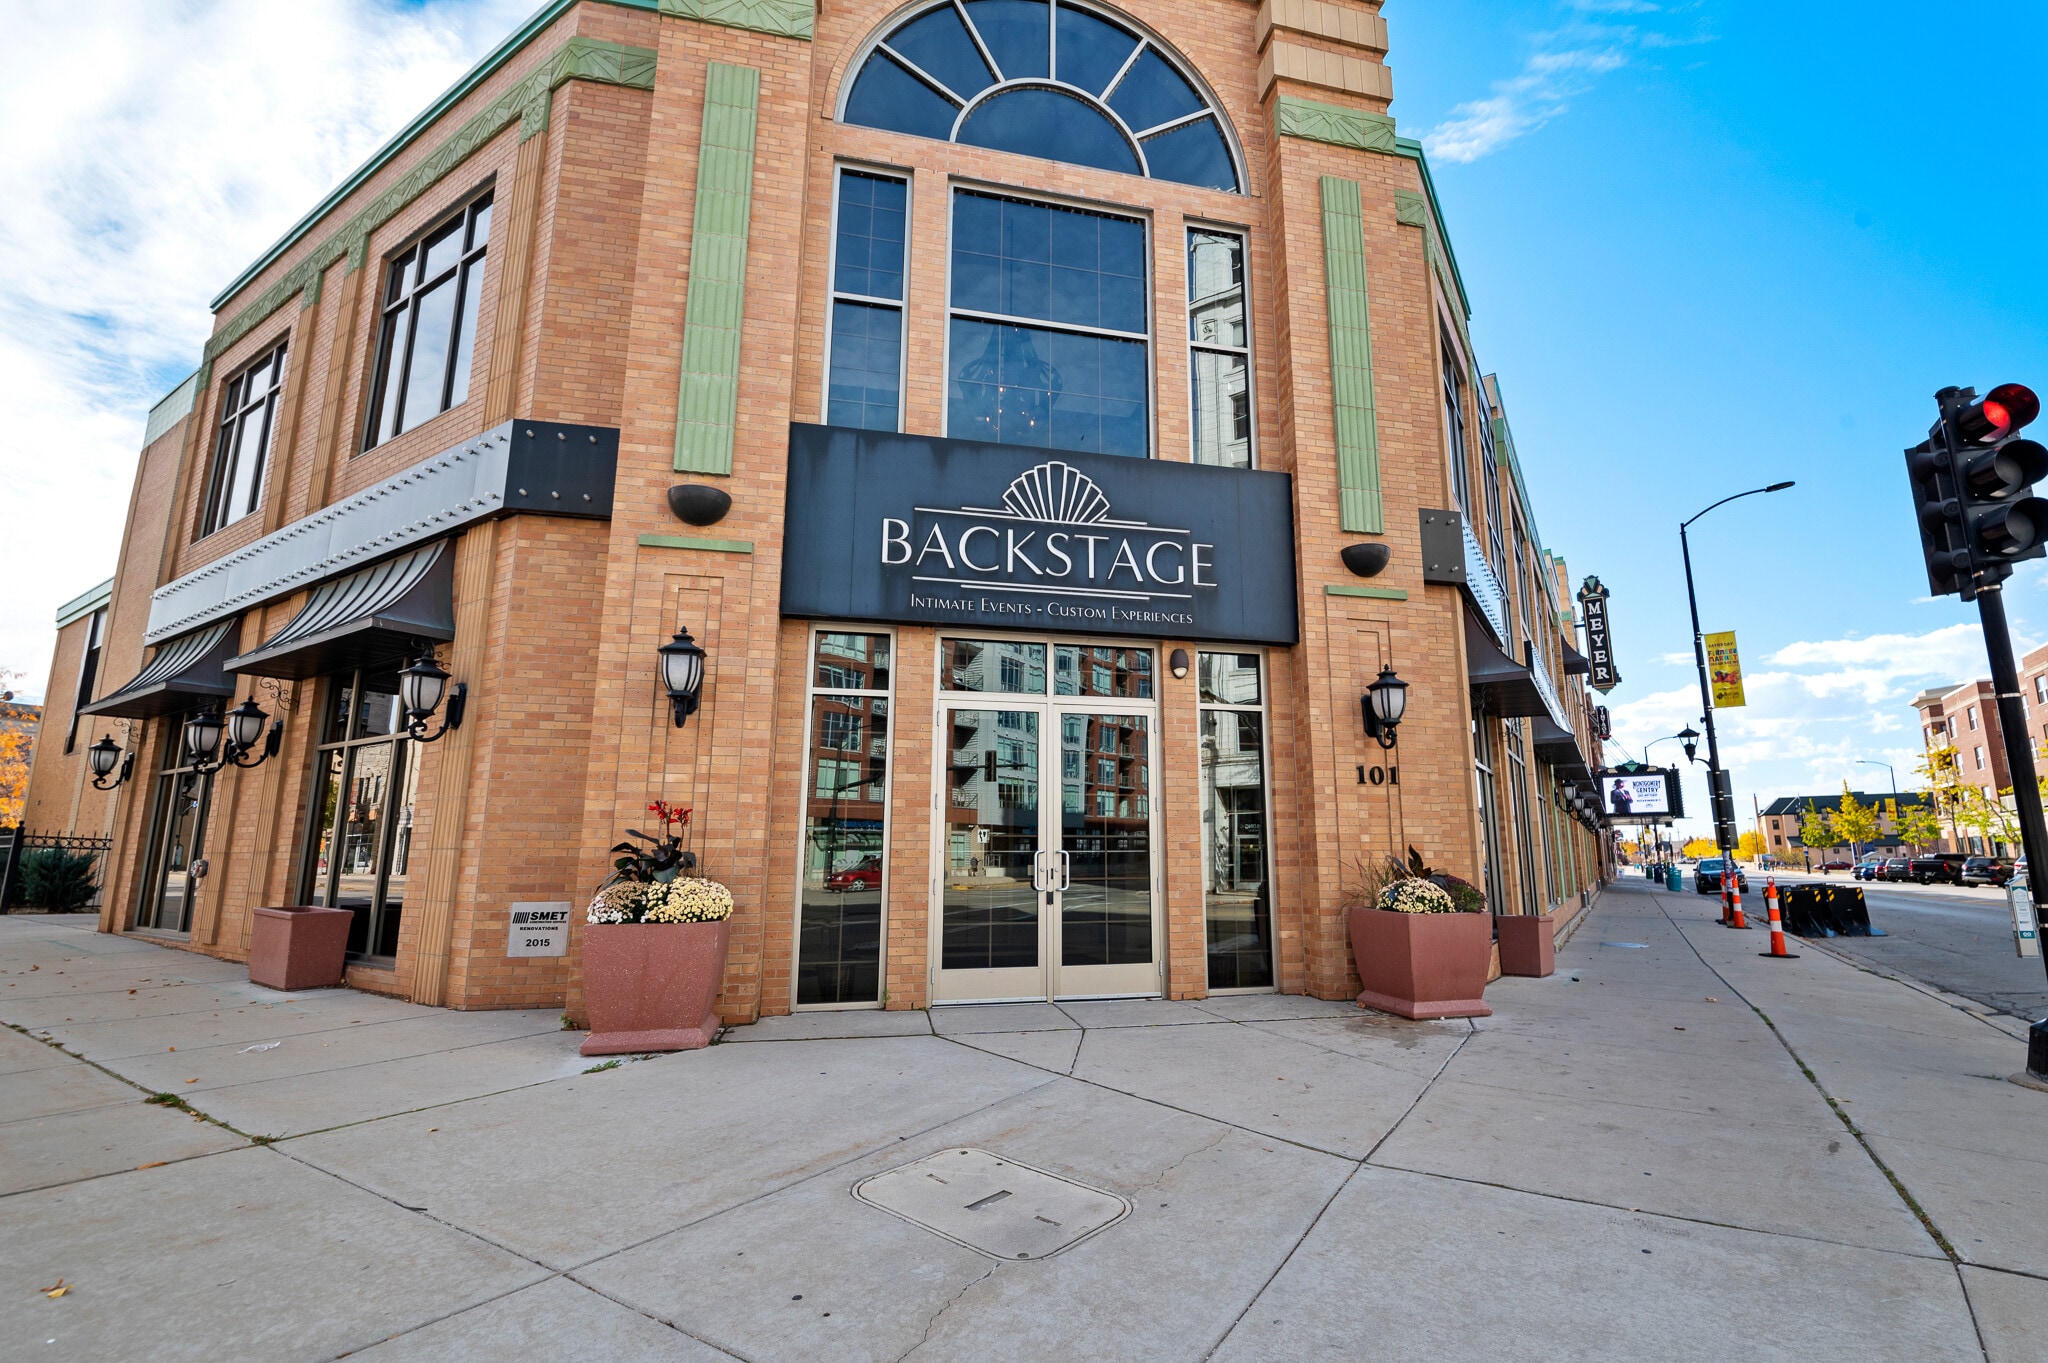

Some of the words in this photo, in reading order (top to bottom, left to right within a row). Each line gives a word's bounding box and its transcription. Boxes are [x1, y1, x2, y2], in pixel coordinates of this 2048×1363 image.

[881, 517, 1218, 587] BACKSTAGE
[1587, 601, 1610, 680] MEYER
[1356, 765, 1399, 785] 101
[530, 912, 568, 920] SMET
[526, 939, 550, 947] 2015
